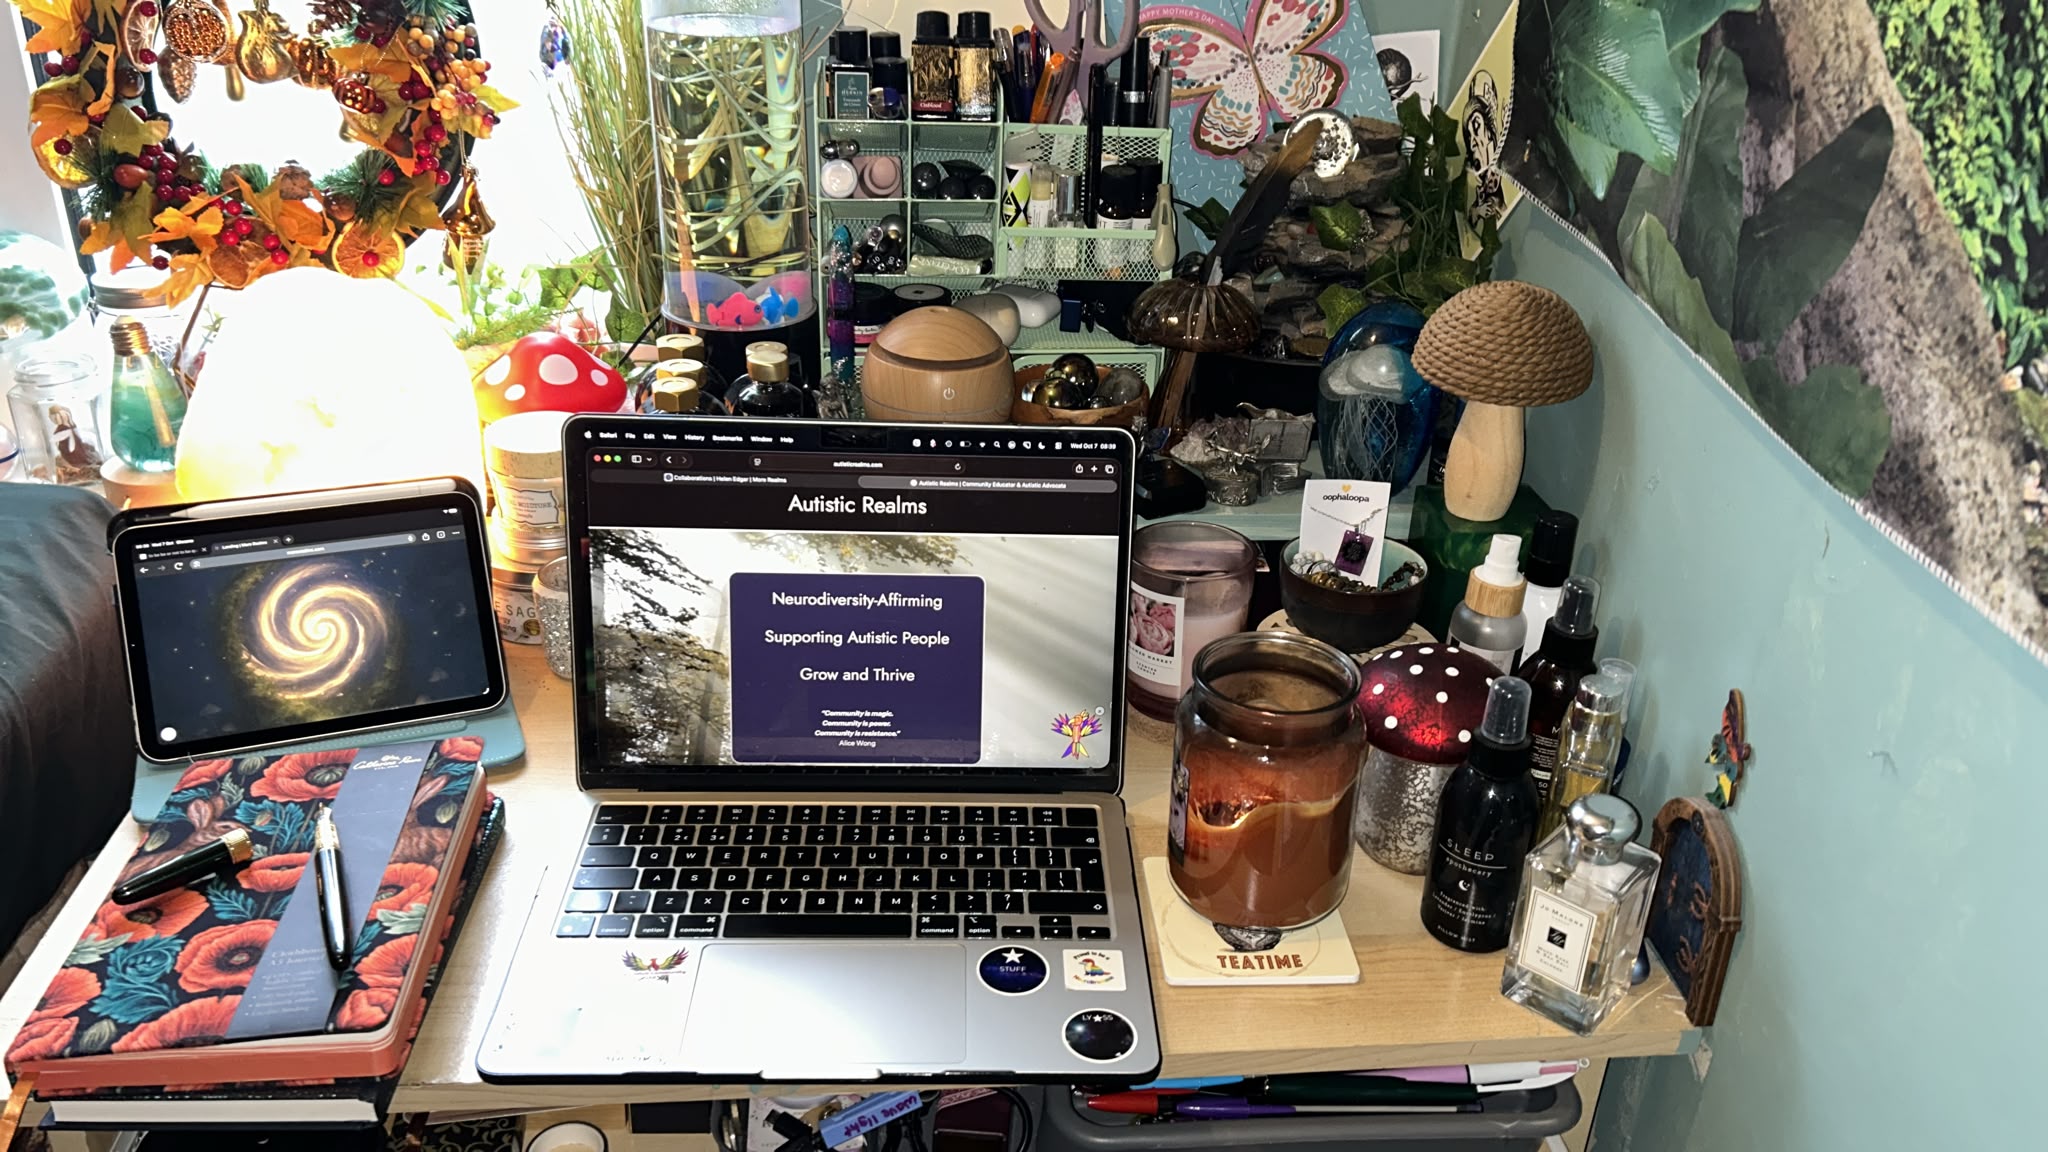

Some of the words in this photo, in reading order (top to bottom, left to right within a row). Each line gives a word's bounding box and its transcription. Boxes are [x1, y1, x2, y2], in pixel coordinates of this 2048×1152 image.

[1162, 8, 1200, 18] MOTHER'S
[1201, 14, 1216, 24] DAY
[962, 481, 992, 489] Community
[788, 494, 856, 513] Autistic
[862, 495, 927, 515] Realms
[1322, 493, 1370, 503] oophaloopa
[772, 591, 943, 611] Neurodiversity-Affirming
[506, 604, 537, 619] SAG
[765, 630, 843, 647] Supporting
[847, 631, 898, 644] Autistic
[902, 631, 950, 648] People
[800, 667, 838, 681] Grow
[843, 667, 869, 681] and
[873, 668, 915, 682] Thrive
[871, 710, 894, 718] magic.
[822, 720, 862, 728] Community
[856, 740, 877, 748] Wong
[1446, 838, 1494, 862] SLEEP
[1445, 857, 1492, 878] apothecary
[643, 926, 665, 934] option
[969, 926, 991, 934] option
[1217, 954, 1303, 970] TEATIME
[881, 1095, 918, 1118] wave
[844, 1114, 879, 1137] light
